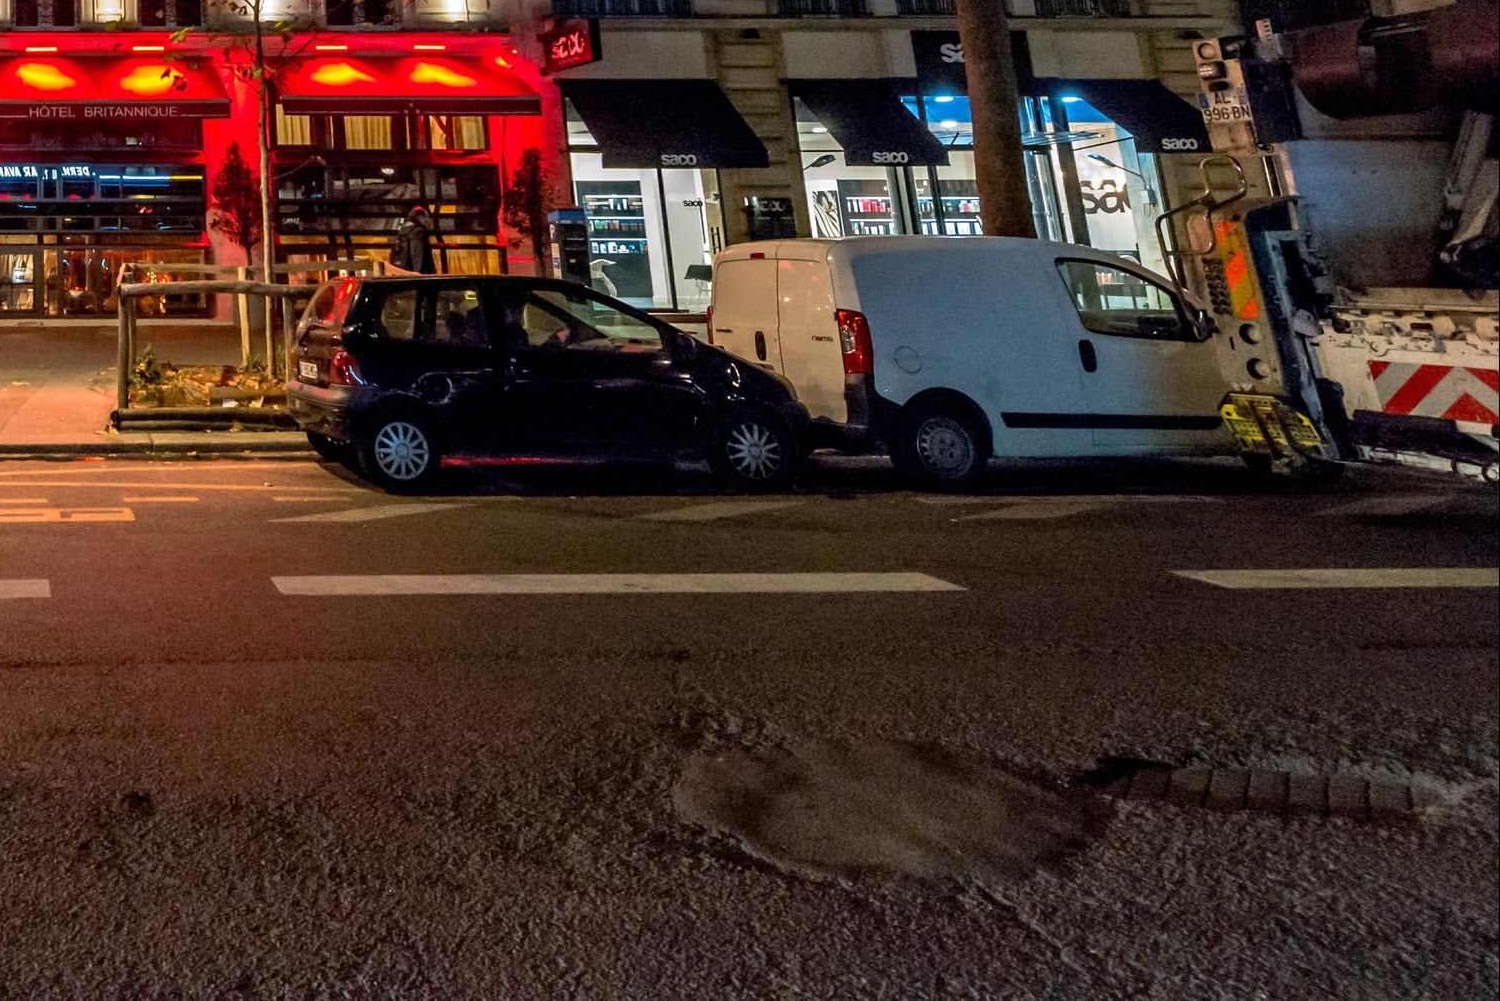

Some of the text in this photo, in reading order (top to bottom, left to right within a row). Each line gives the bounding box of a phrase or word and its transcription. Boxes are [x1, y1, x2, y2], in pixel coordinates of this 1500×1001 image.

[29, 105, 178, 118] HÔTEL BRITANNIQUE
[1161, 138, 1198, 150] saco
[660, 153, 697, 166] saco
[872, 151, 909, 163] saco
[683, 199, 703, 207] saco
